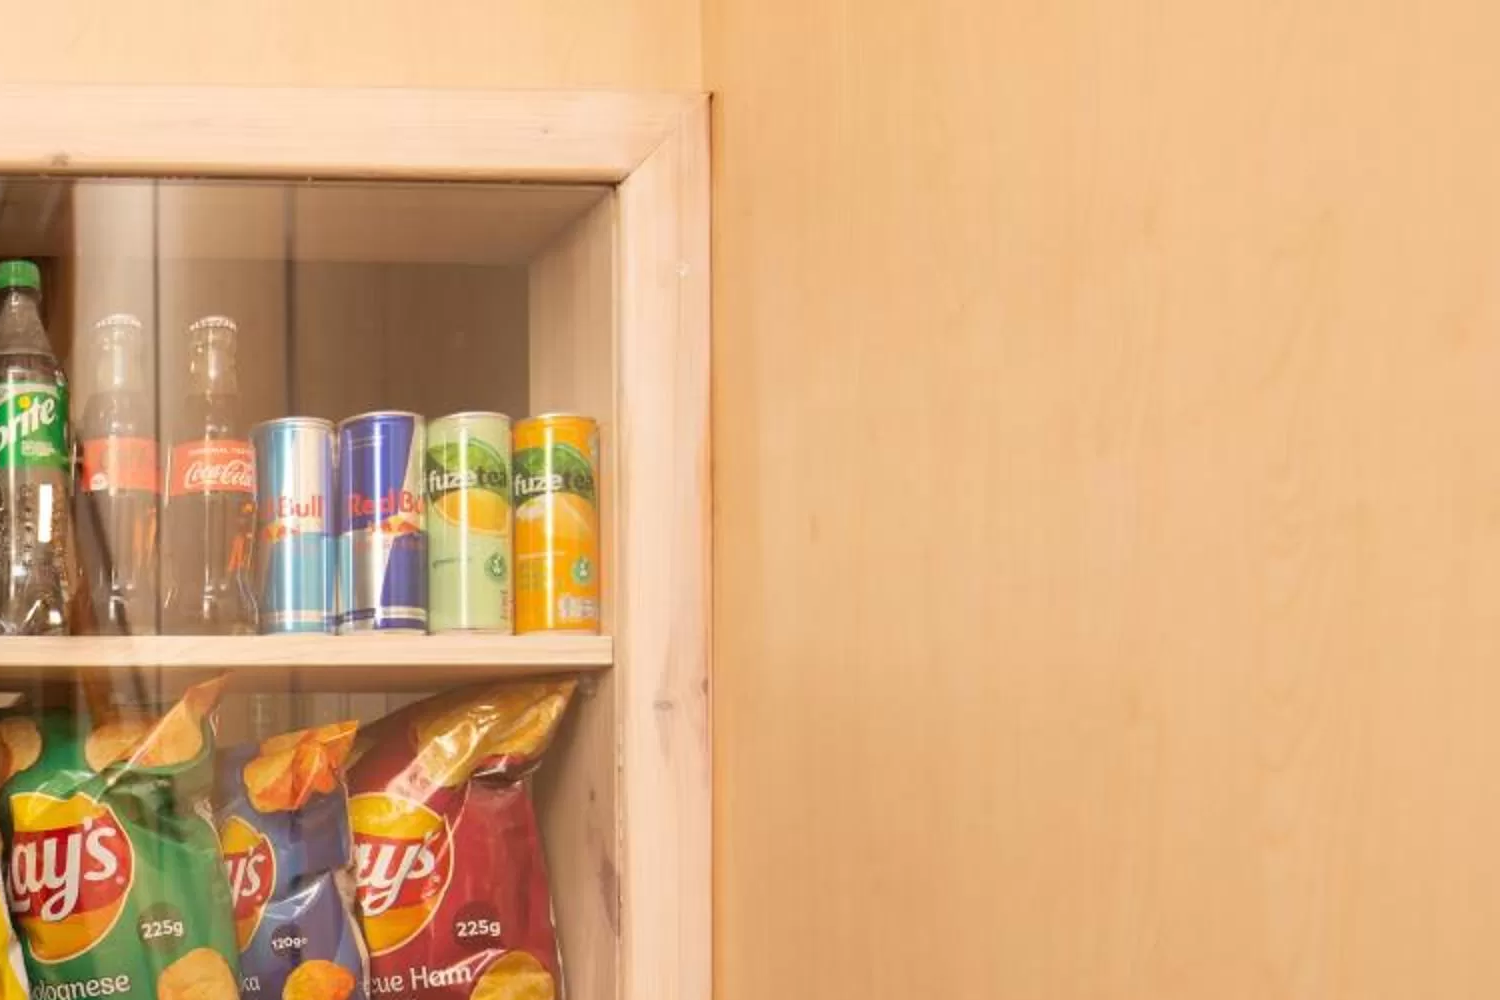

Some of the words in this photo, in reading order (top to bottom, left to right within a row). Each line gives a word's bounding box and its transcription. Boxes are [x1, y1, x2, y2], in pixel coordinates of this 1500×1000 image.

[278, 495, 324, 518] Bull
[348, 489, 395, 516] Red
[401, 491, 427, 515] Bu
[356, 830, 439, 917] ay's
[141, 919, 185, 939] 225g
[455, 919, 501, 938] 225g
[411, 962, 473, 991] Ham
